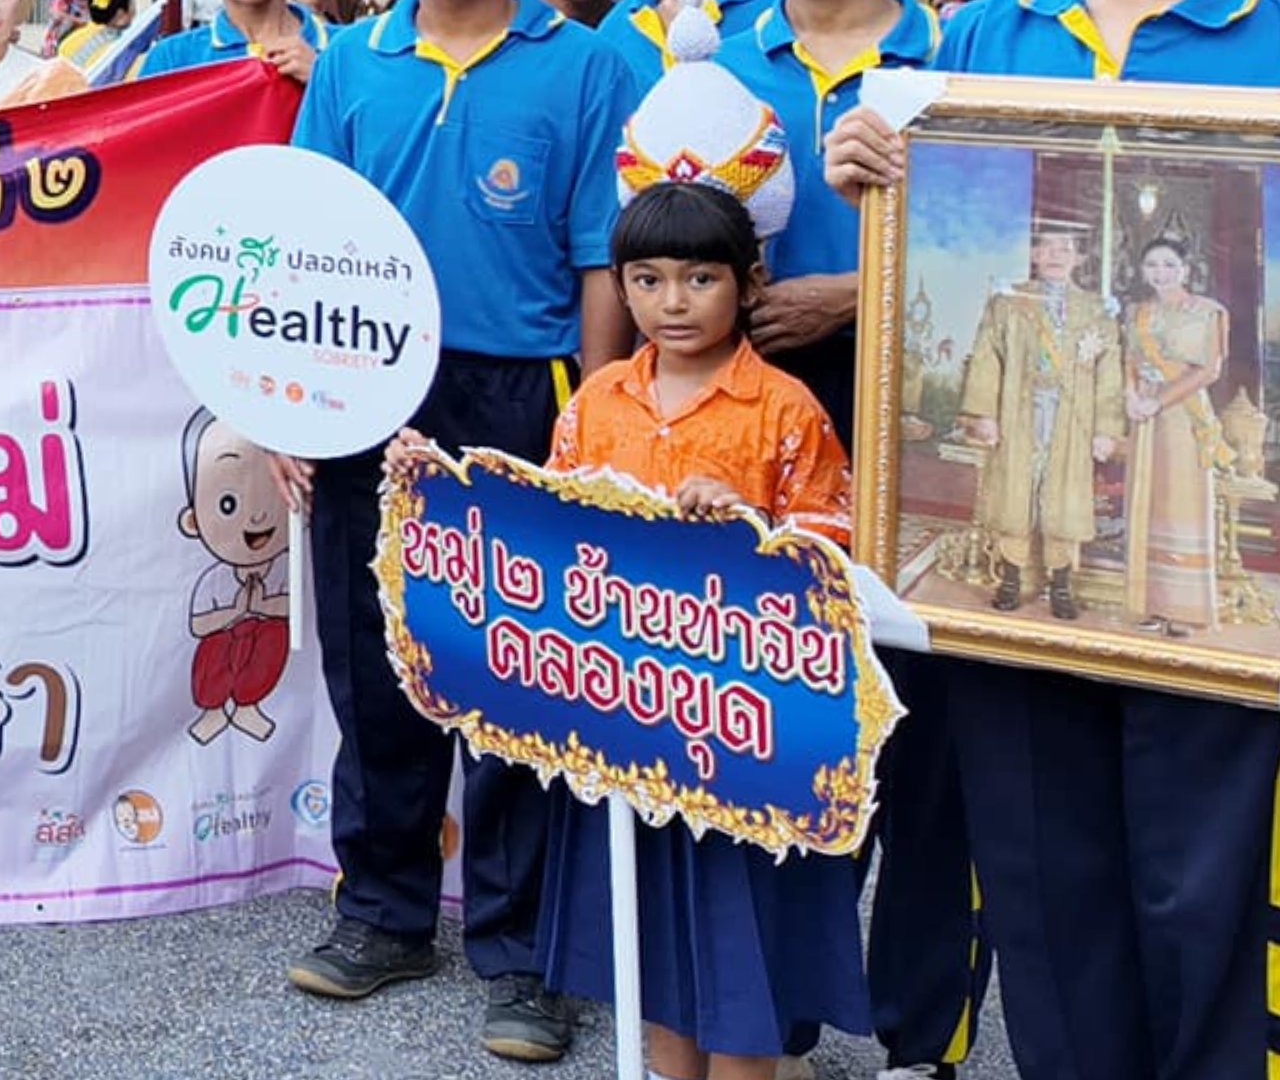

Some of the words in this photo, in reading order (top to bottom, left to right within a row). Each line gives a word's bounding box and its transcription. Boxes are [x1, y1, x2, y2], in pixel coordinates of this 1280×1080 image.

[25, 152, 88, 210] ๒
[169, 273, 412, 367] Healthy
[488, 619, 773, 781] คลองขุด
